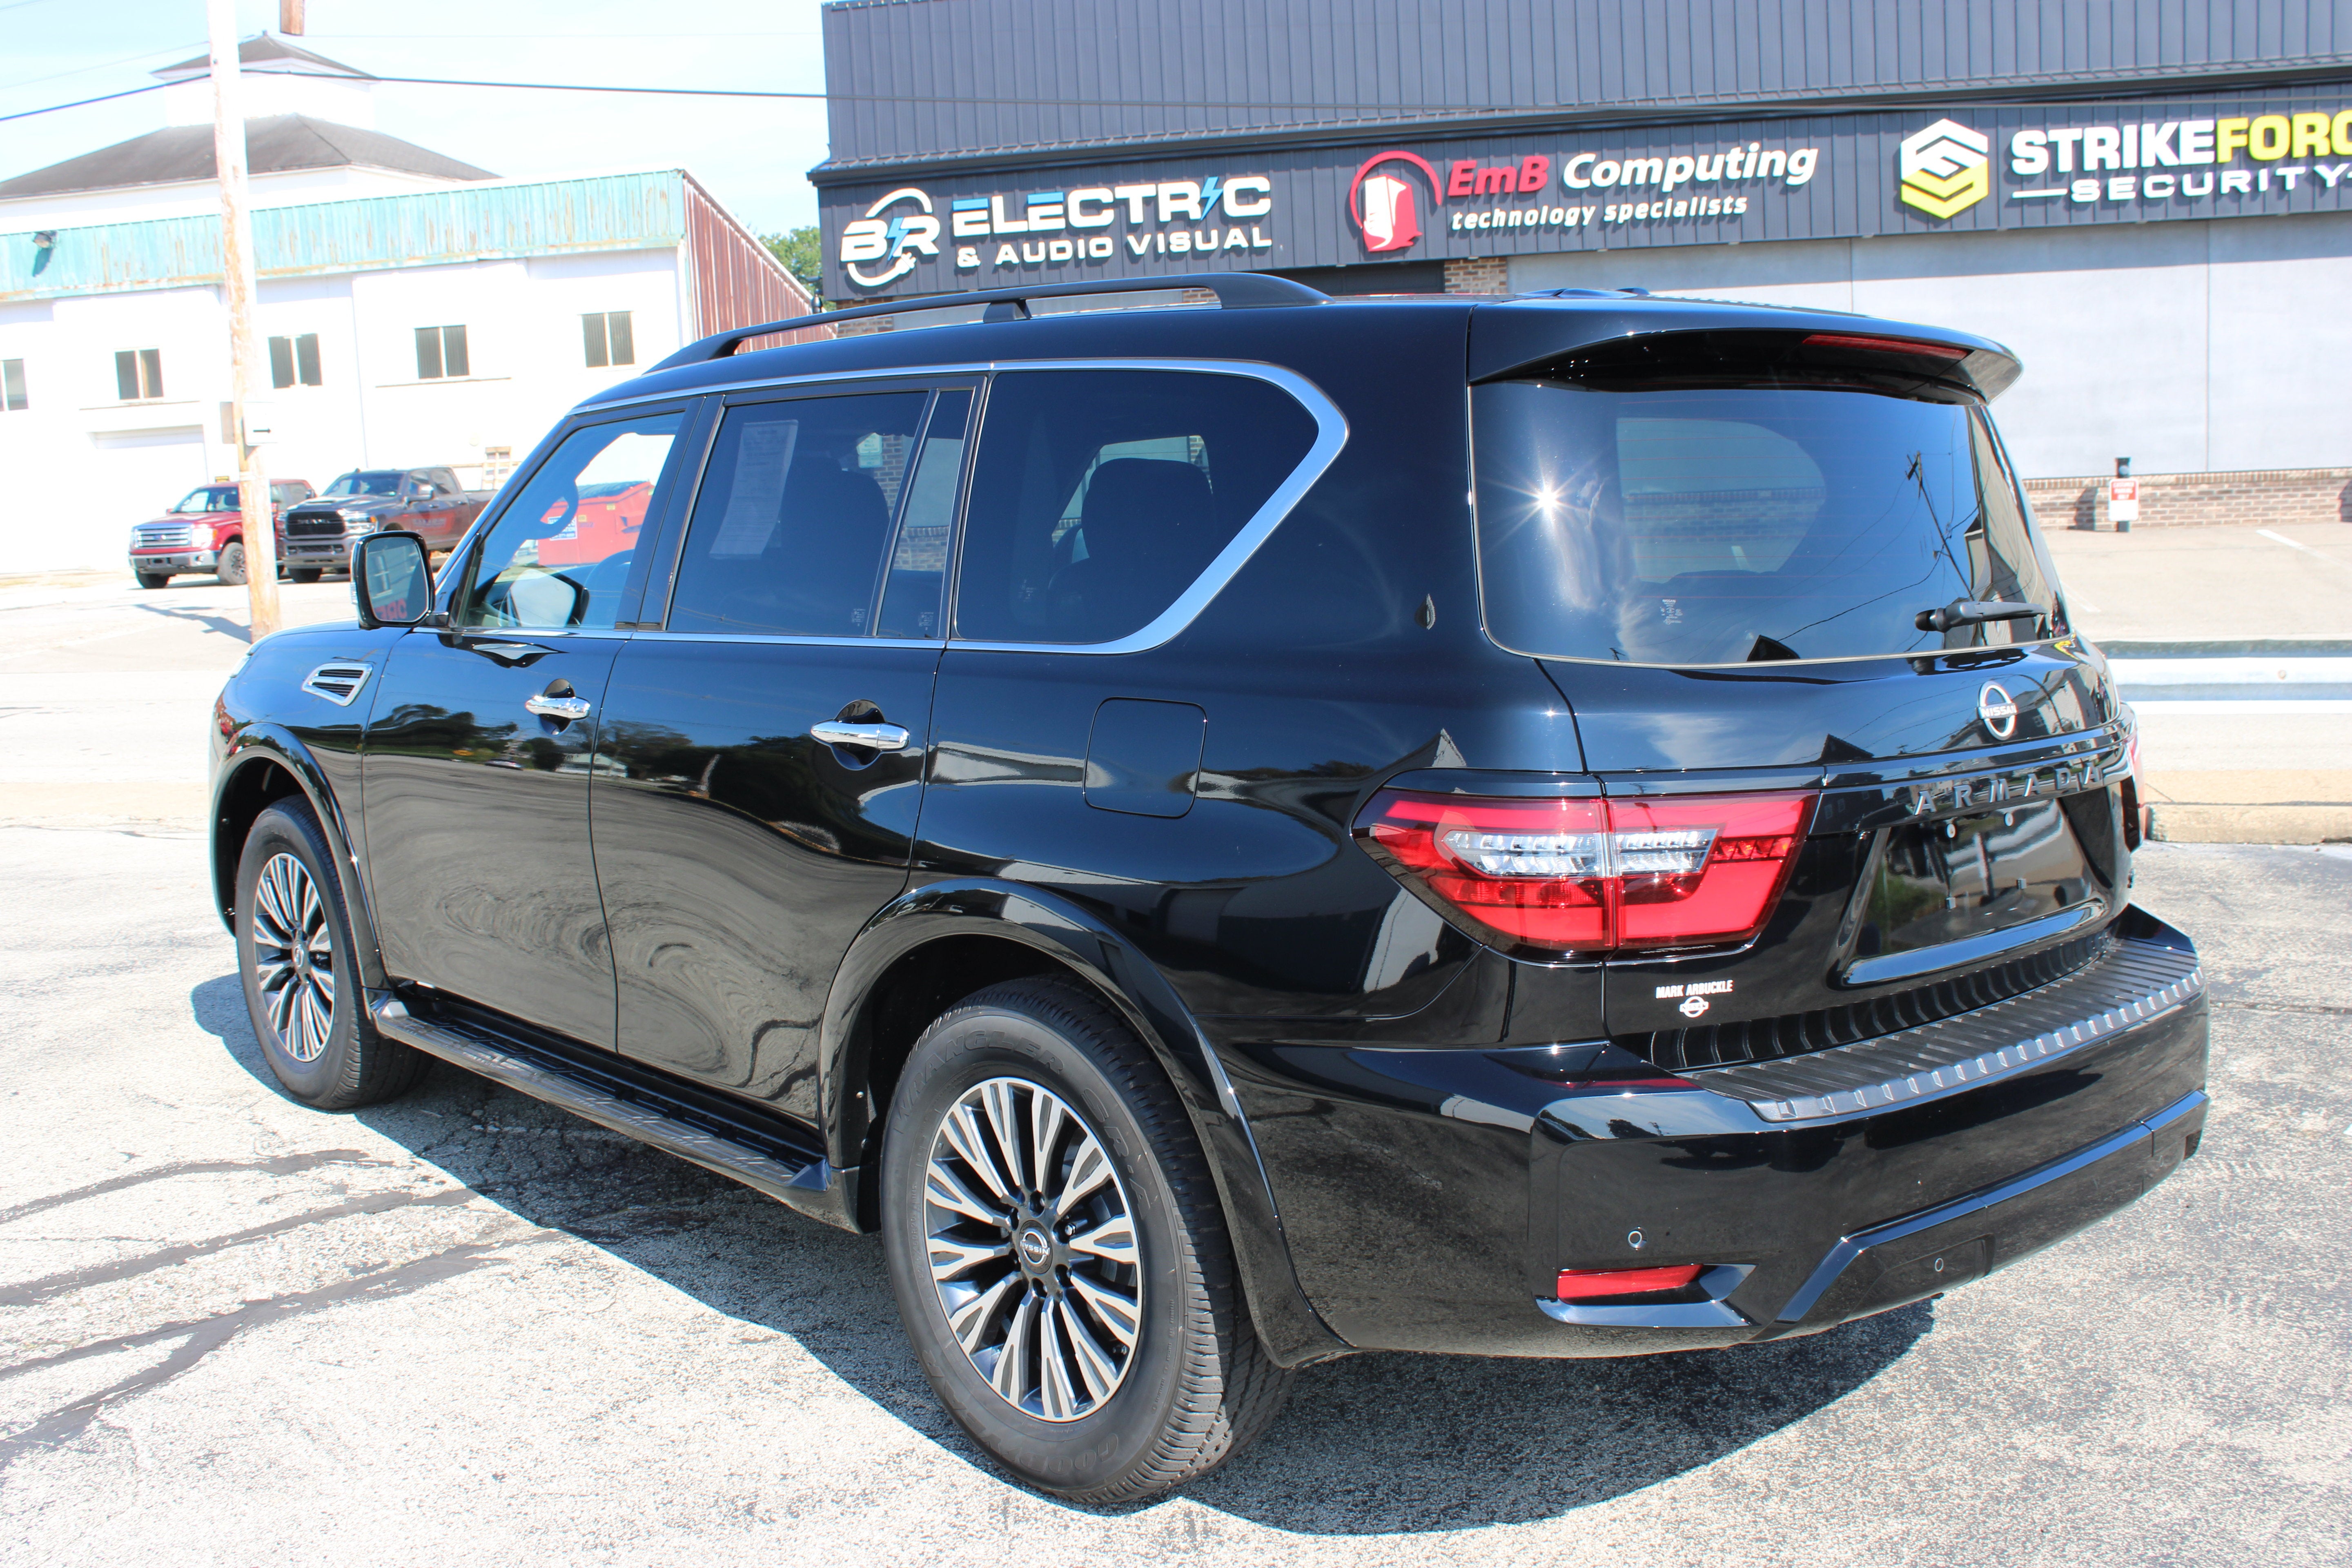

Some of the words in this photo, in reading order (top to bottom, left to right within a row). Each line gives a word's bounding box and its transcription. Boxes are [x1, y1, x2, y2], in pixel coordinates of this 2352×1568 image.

[1447, 155, 1551, 196] EmB
[1563, 142, 1819, 192] Computing
[2071, 163, 2351, 202] SECURITY
[1452, 205, 1596, 230] technology
[1604, 195, 1748, 223] specialists
[957, 247, 981, 267] &
[994, 236, 1114, 265] AUDIO
[1126, 227, 1273, 255] VISUAL
[1980, 705, 2017, 717] NISSAN
[1913, 762, 2102, 816] ARMADA
[1655, 984, 1685, 999] MARK
[1685, 979, 1733, 996] ARBUCKLE
[894, 1030, 1065, 1134] WRANGLER
[1021, 1241, 1049, 1255] NISSAN
